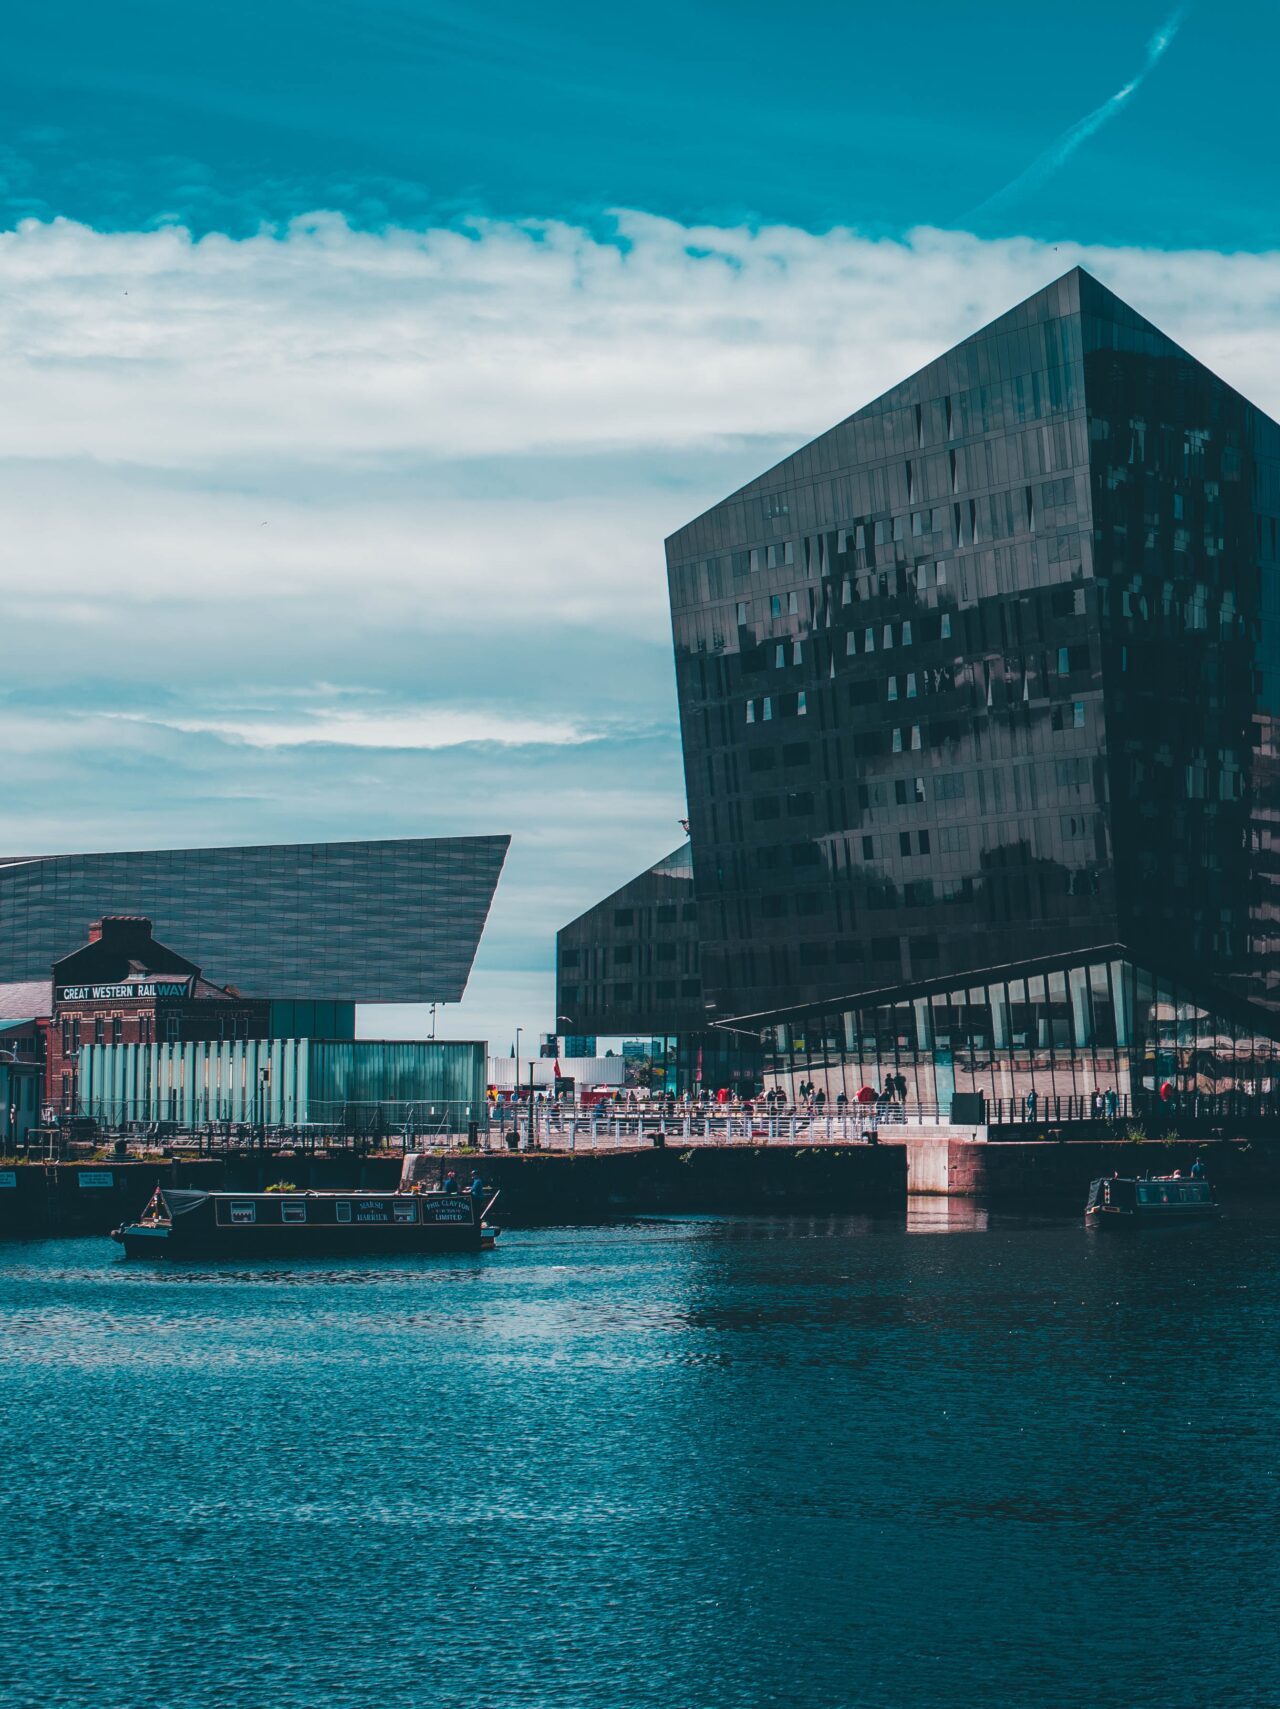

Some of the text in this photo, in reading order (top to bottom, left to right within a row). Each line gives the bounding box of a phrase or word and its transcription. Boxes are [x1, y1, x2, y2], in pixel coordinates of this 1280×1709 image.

[63, 984, 188, 1000] GREAT WESTERN RAILWAY
[441, 1200, 470, 1211] CLAYTON
